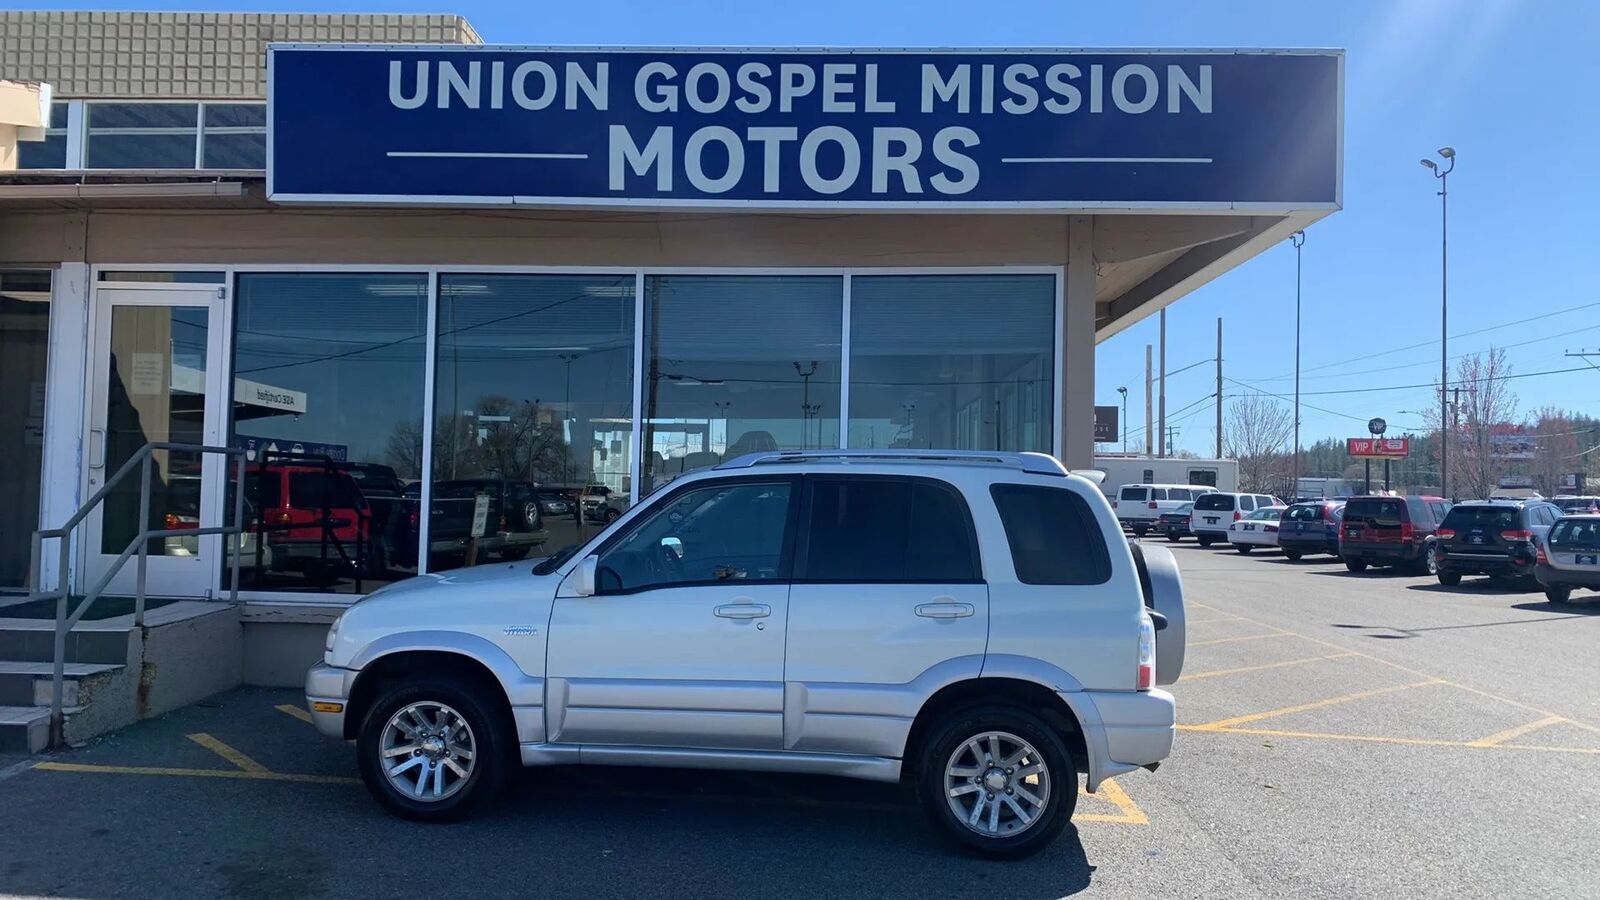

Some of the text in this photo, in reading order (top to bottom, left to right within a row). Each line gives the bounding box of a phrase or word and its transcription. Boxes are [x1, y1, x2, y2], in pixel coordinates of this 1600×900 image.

[388, 60, 1213, 115] UNION GOSPEL MISSION
[608, 124, 981, 195] MOTORS
[1354, 441, 1369, 452] VIP
